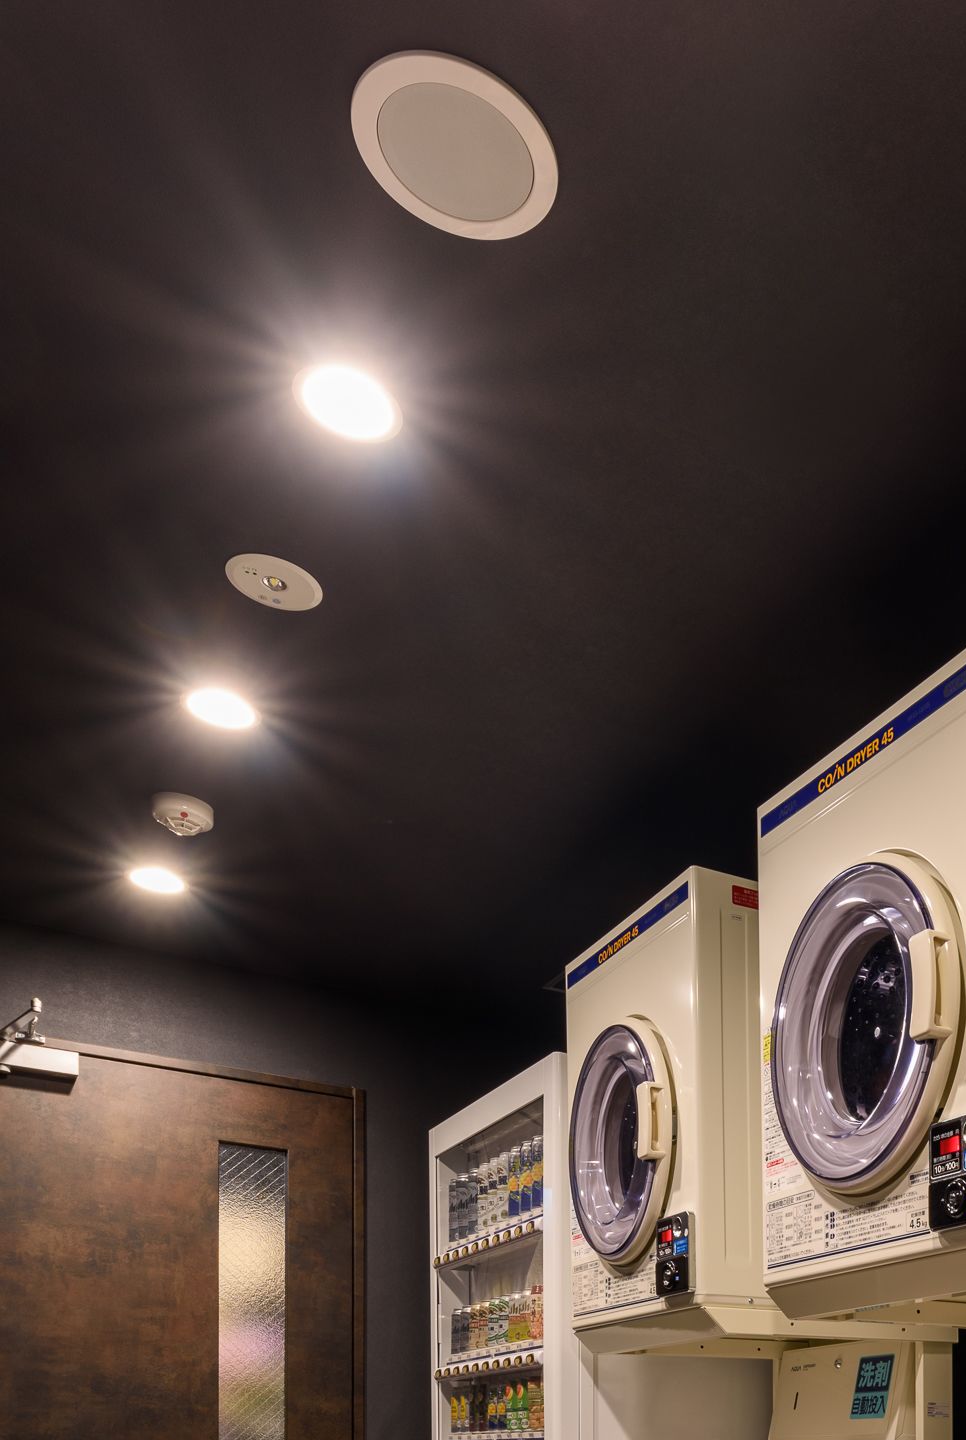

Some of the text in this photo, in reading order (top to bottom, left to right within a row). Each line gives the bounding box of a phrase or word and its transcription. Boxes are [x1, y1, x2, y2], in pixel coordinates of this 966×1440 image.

[846, 740, 880, 775] DRYER
[881, 727, 894, 746] 45
[614, 932, 631, 953] DRYER
[631, 925, 639, 938] 45
[858, 1360, 891, 1388] 洗剤
[851, 1396, 886, 1415] 自動投入
